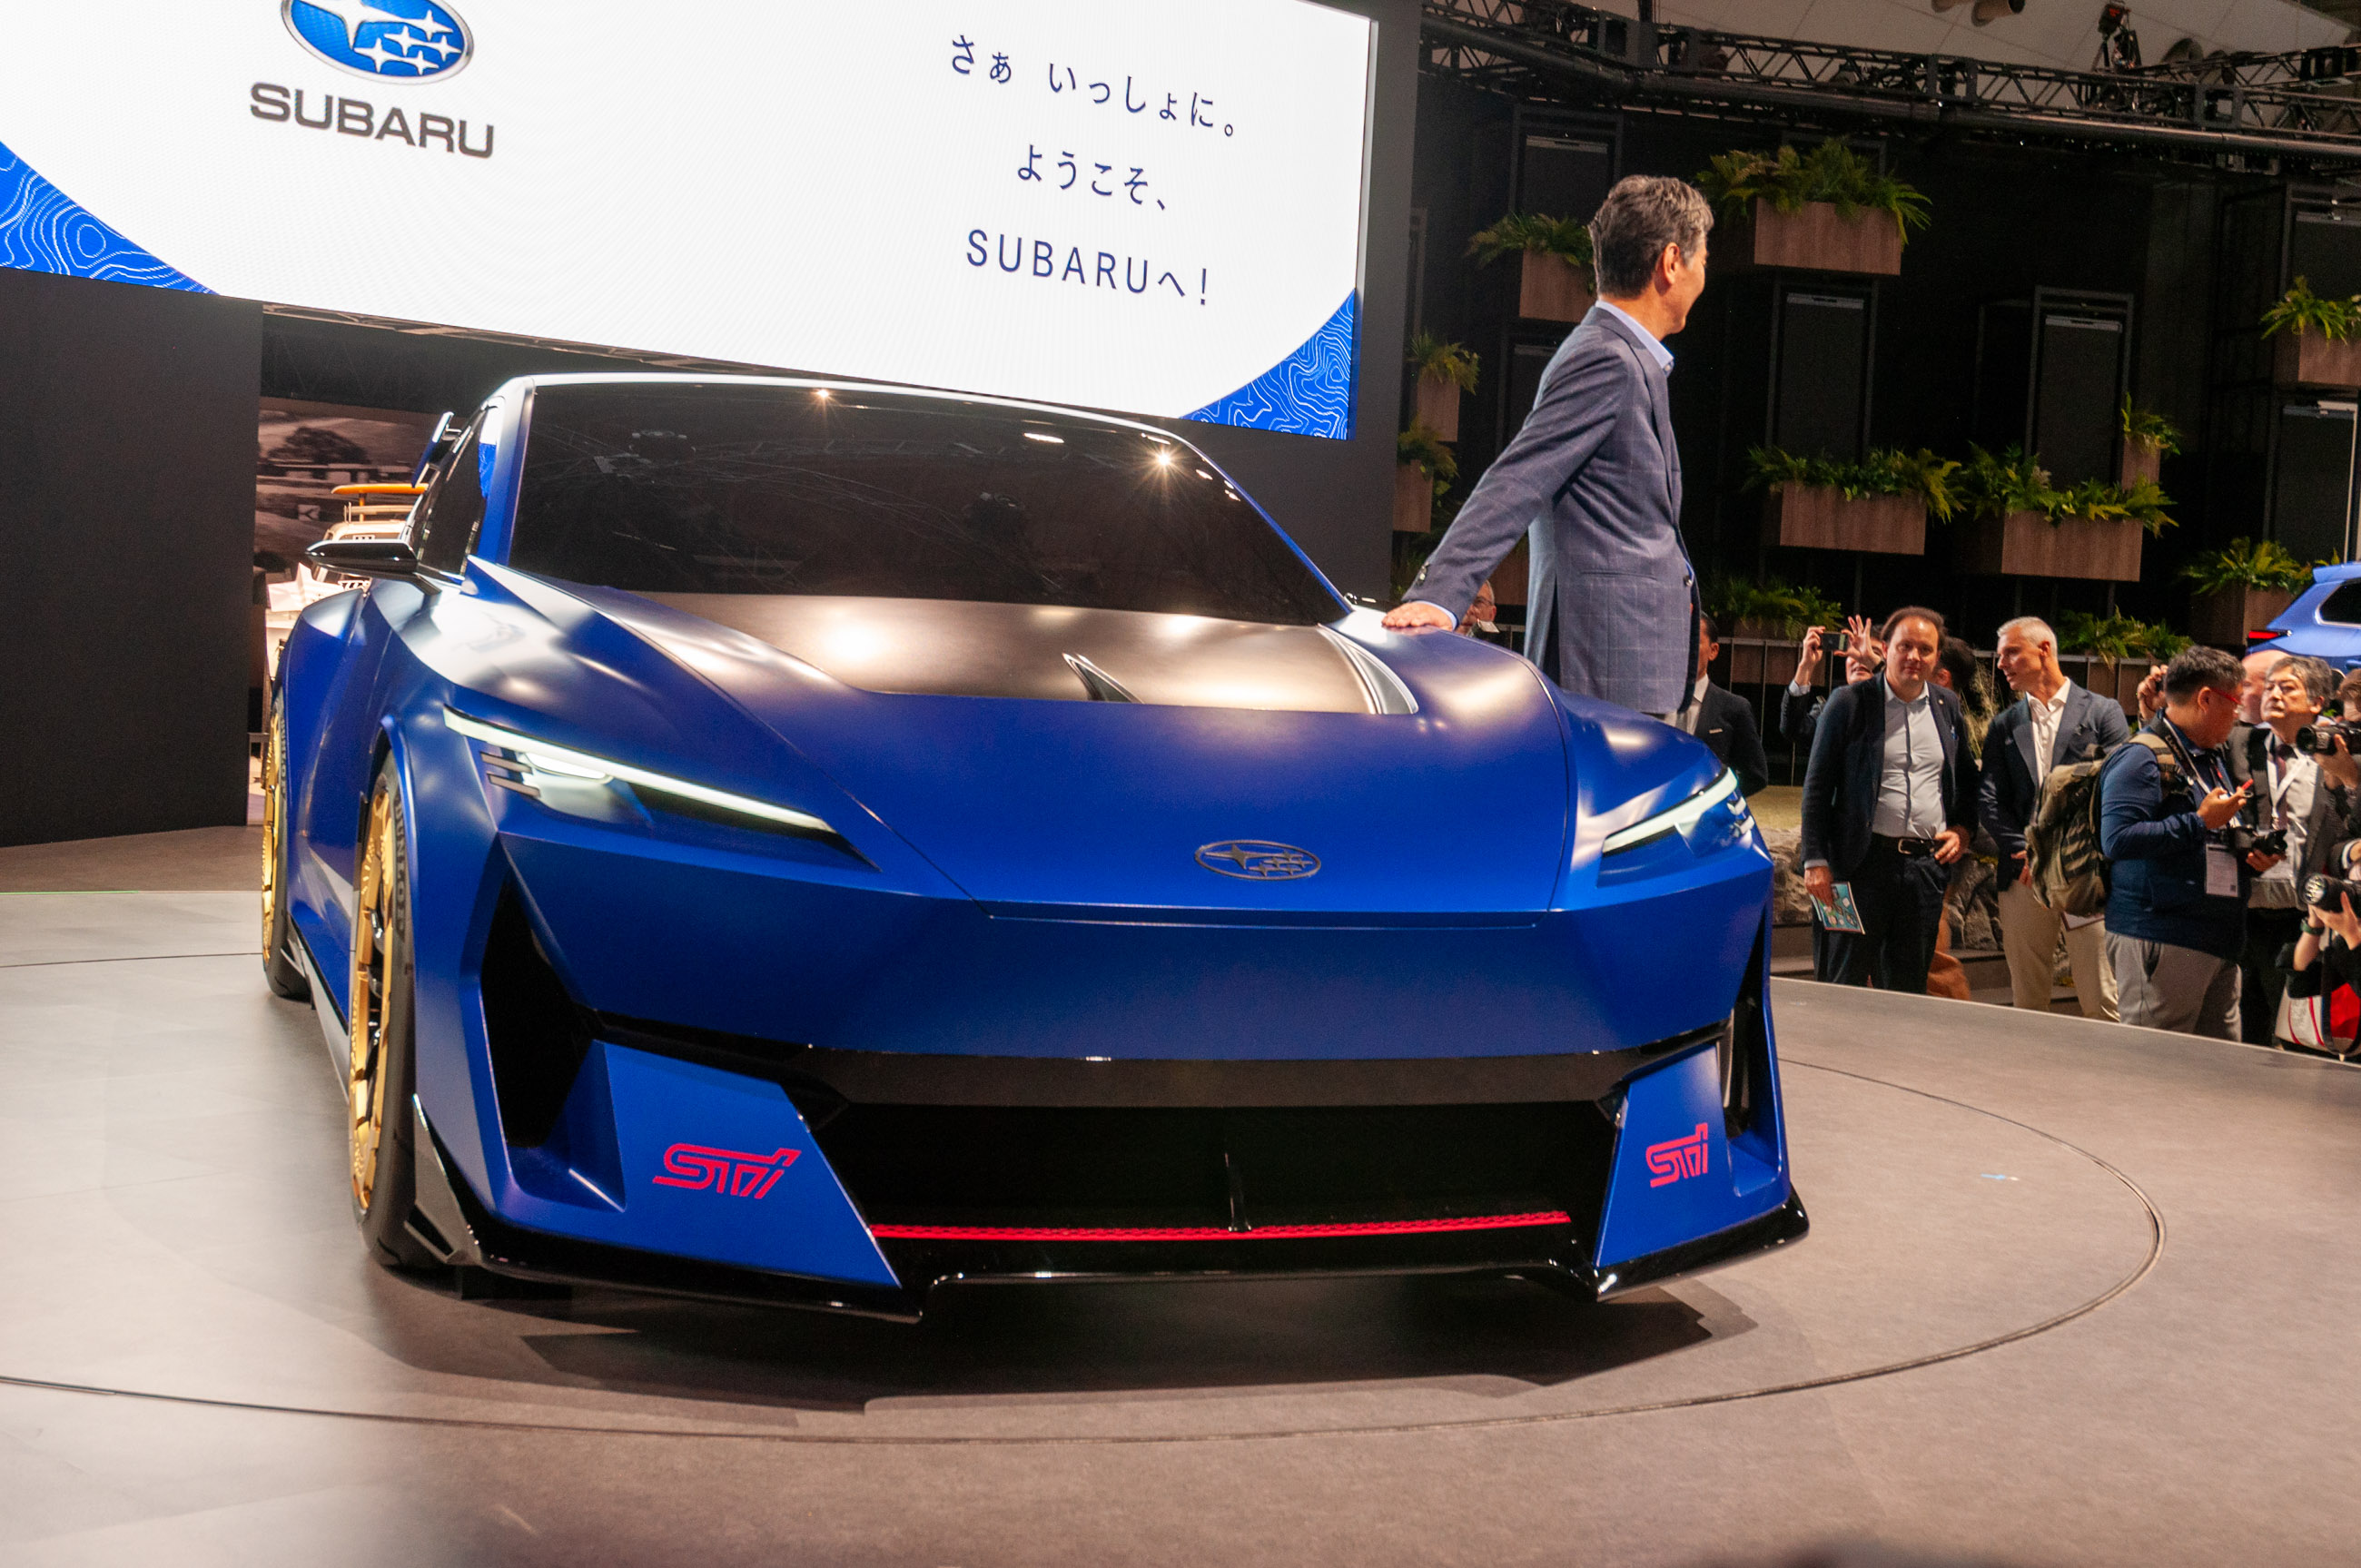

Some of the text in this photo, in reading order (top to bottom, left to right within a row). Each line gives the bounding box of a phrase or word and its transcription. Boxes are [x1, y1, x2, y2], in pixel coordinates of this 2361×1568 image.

[250, 82, 494, 159] SUBARU
[1017, 143, 1166, 212] ようこそ、
[393, 801, 406, 932] DUNLOP
